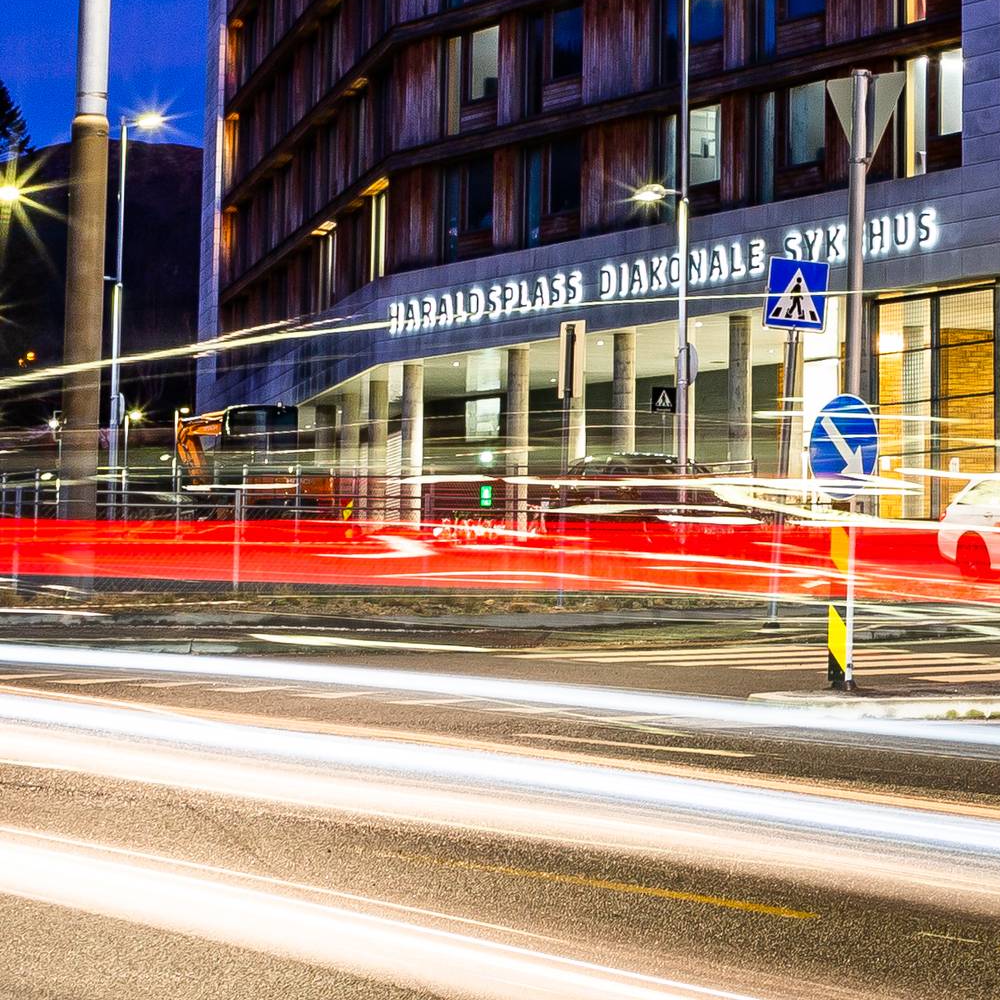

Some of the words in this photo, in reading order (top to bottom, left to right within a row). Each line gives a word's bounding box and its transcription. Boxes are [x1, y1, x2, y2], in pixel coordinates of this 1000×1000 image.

[388, 270, 582, 335] HARALDSPLASS
[599, 238, 766, 299] DIAKONALE
[784, 207, 937, 262] SYKHUS
